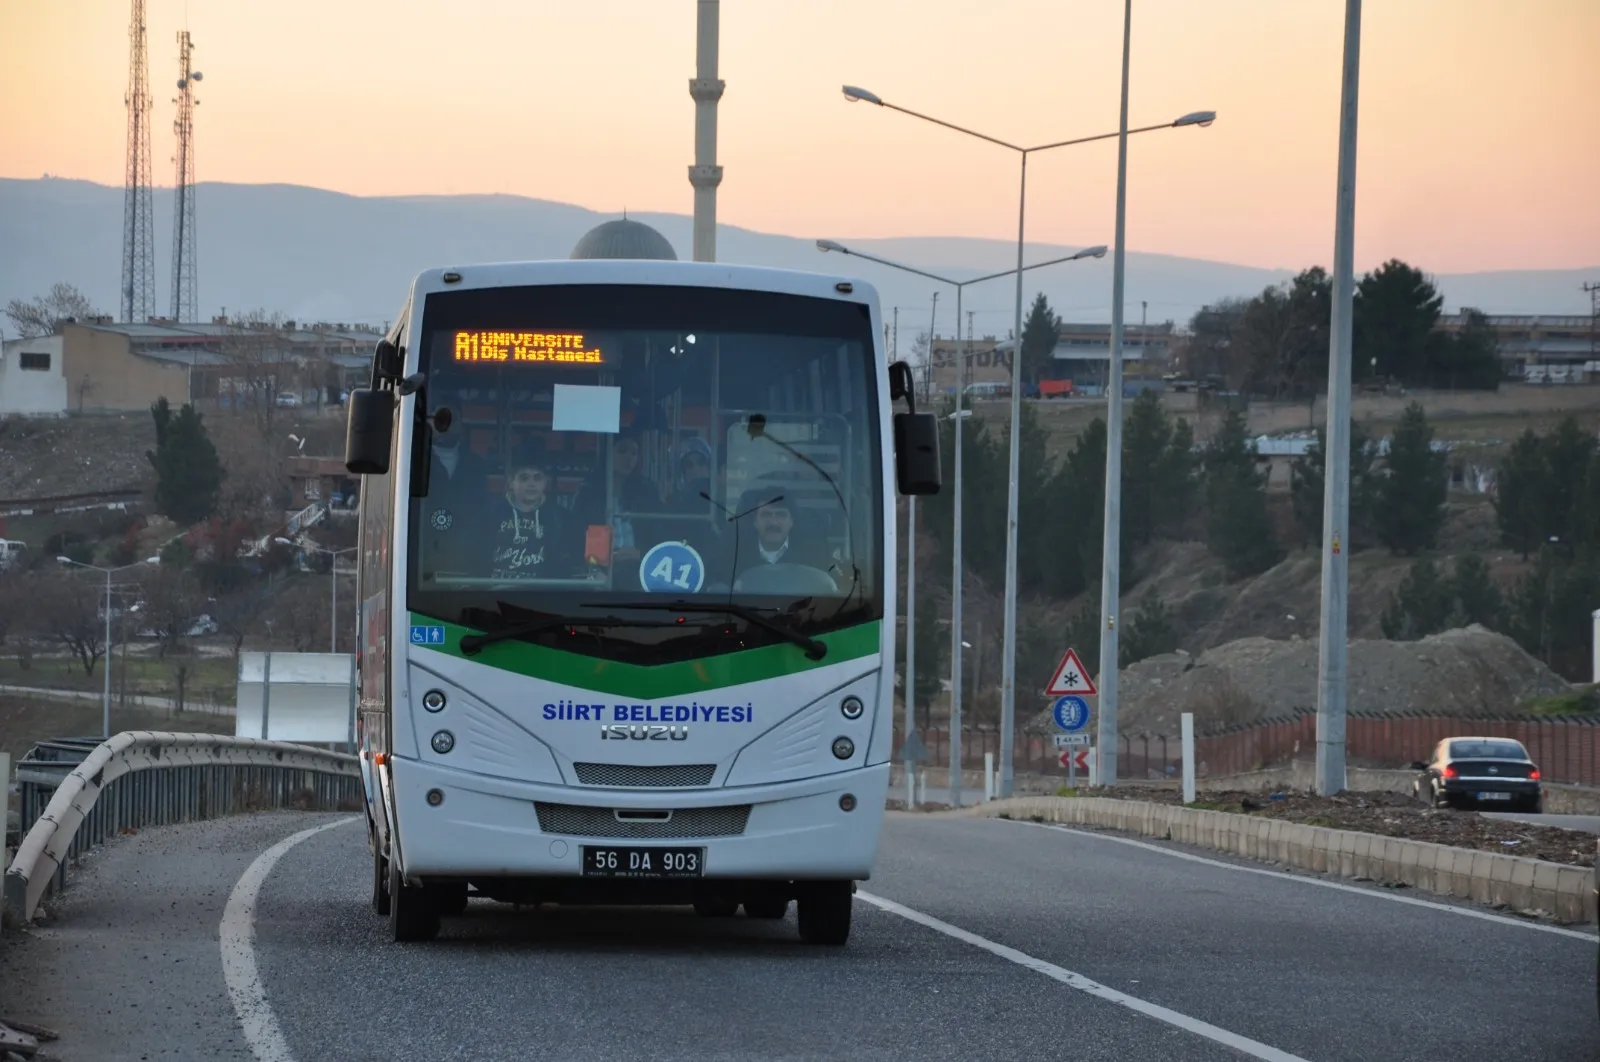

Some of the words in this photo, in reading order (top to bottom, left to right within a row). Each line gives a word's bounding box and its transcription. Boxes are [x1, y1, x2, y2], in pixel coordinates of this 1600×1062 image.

[455, 332, 478, 360] A1
[514, 346, 602, 362] Hastanesi
[650, 556, 693, 590] A1
[542, 700, 605, 721] SİİRT
[614, 702, 753, 723] BELEDİYESİ
[601, 724, 689, 741] ISUZU
[595, 851, 618, 869] 56
[630, 852, 651, 870] DA
[663, 853, 697, 871] 903
